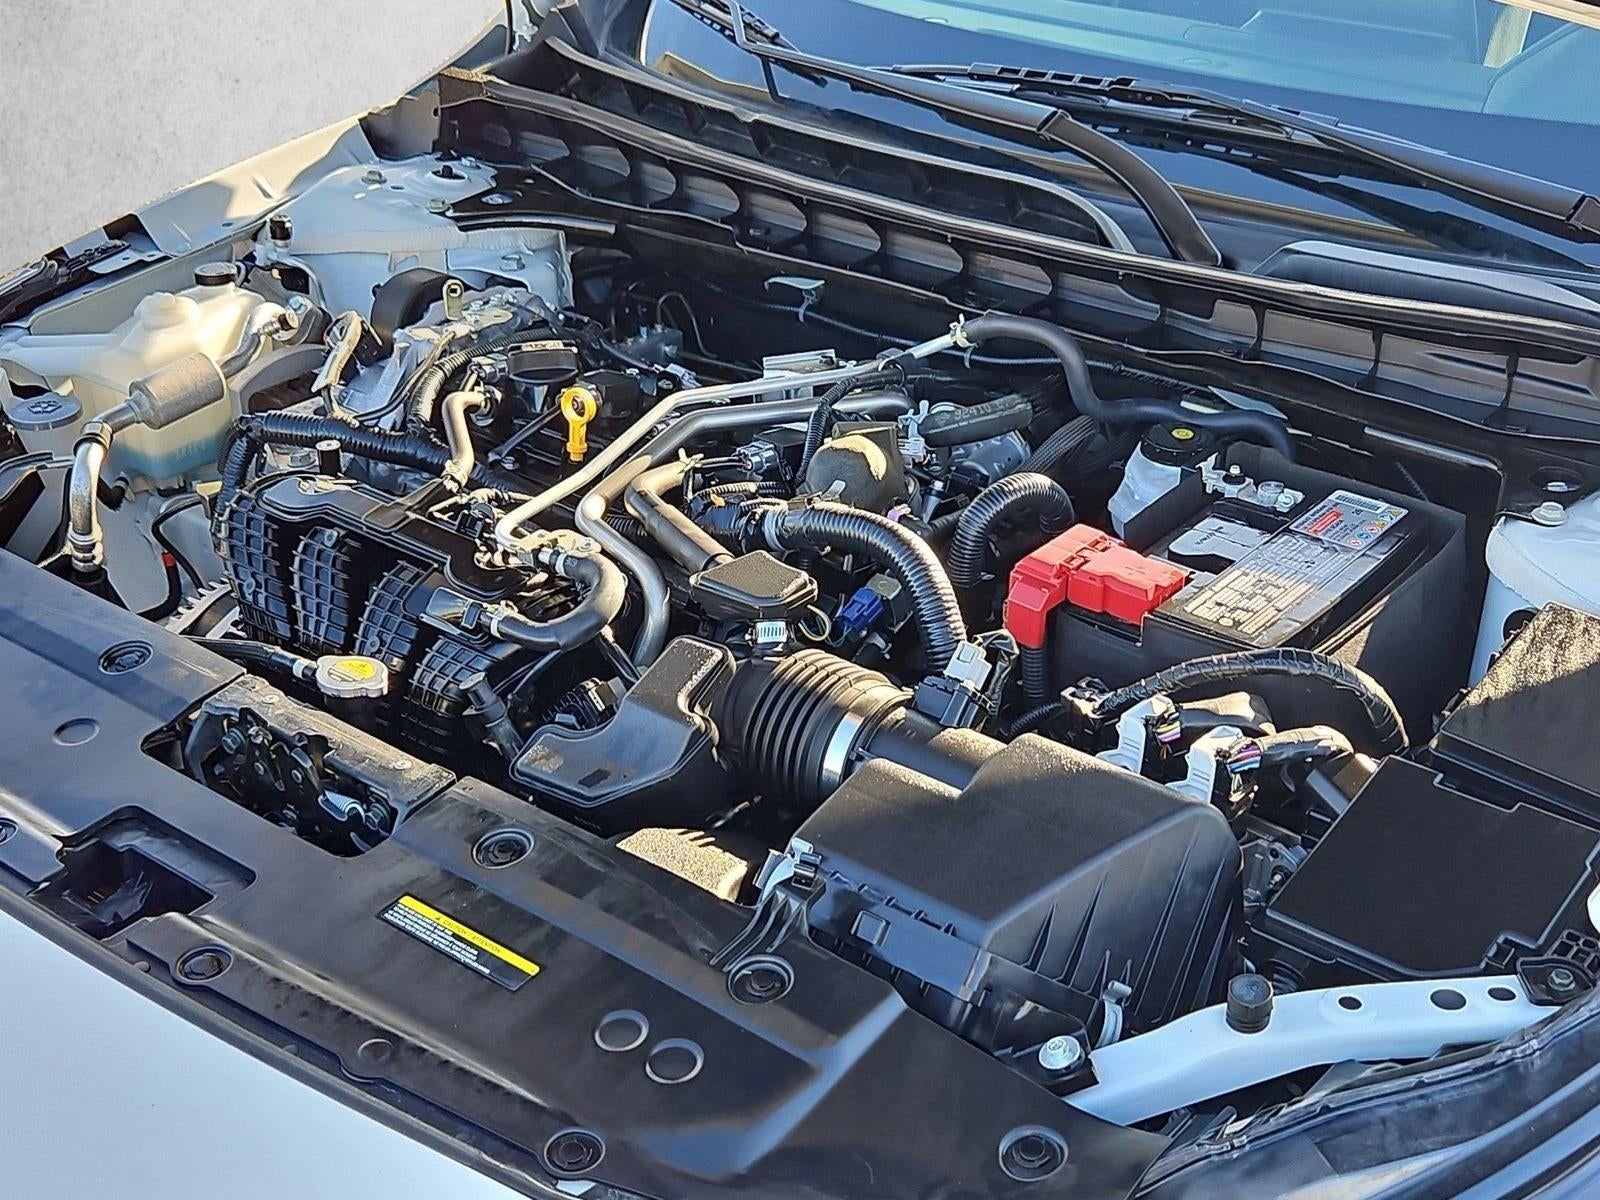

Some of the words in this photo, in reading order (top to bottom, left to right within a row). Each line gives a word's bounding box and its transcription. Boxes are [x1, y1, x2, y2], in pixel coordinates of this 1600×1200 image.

[954, 403, 991, 420] 92410
[443, 919, 467, 935] CAUTION
[472, 935, 502, 953] ATTENTION
